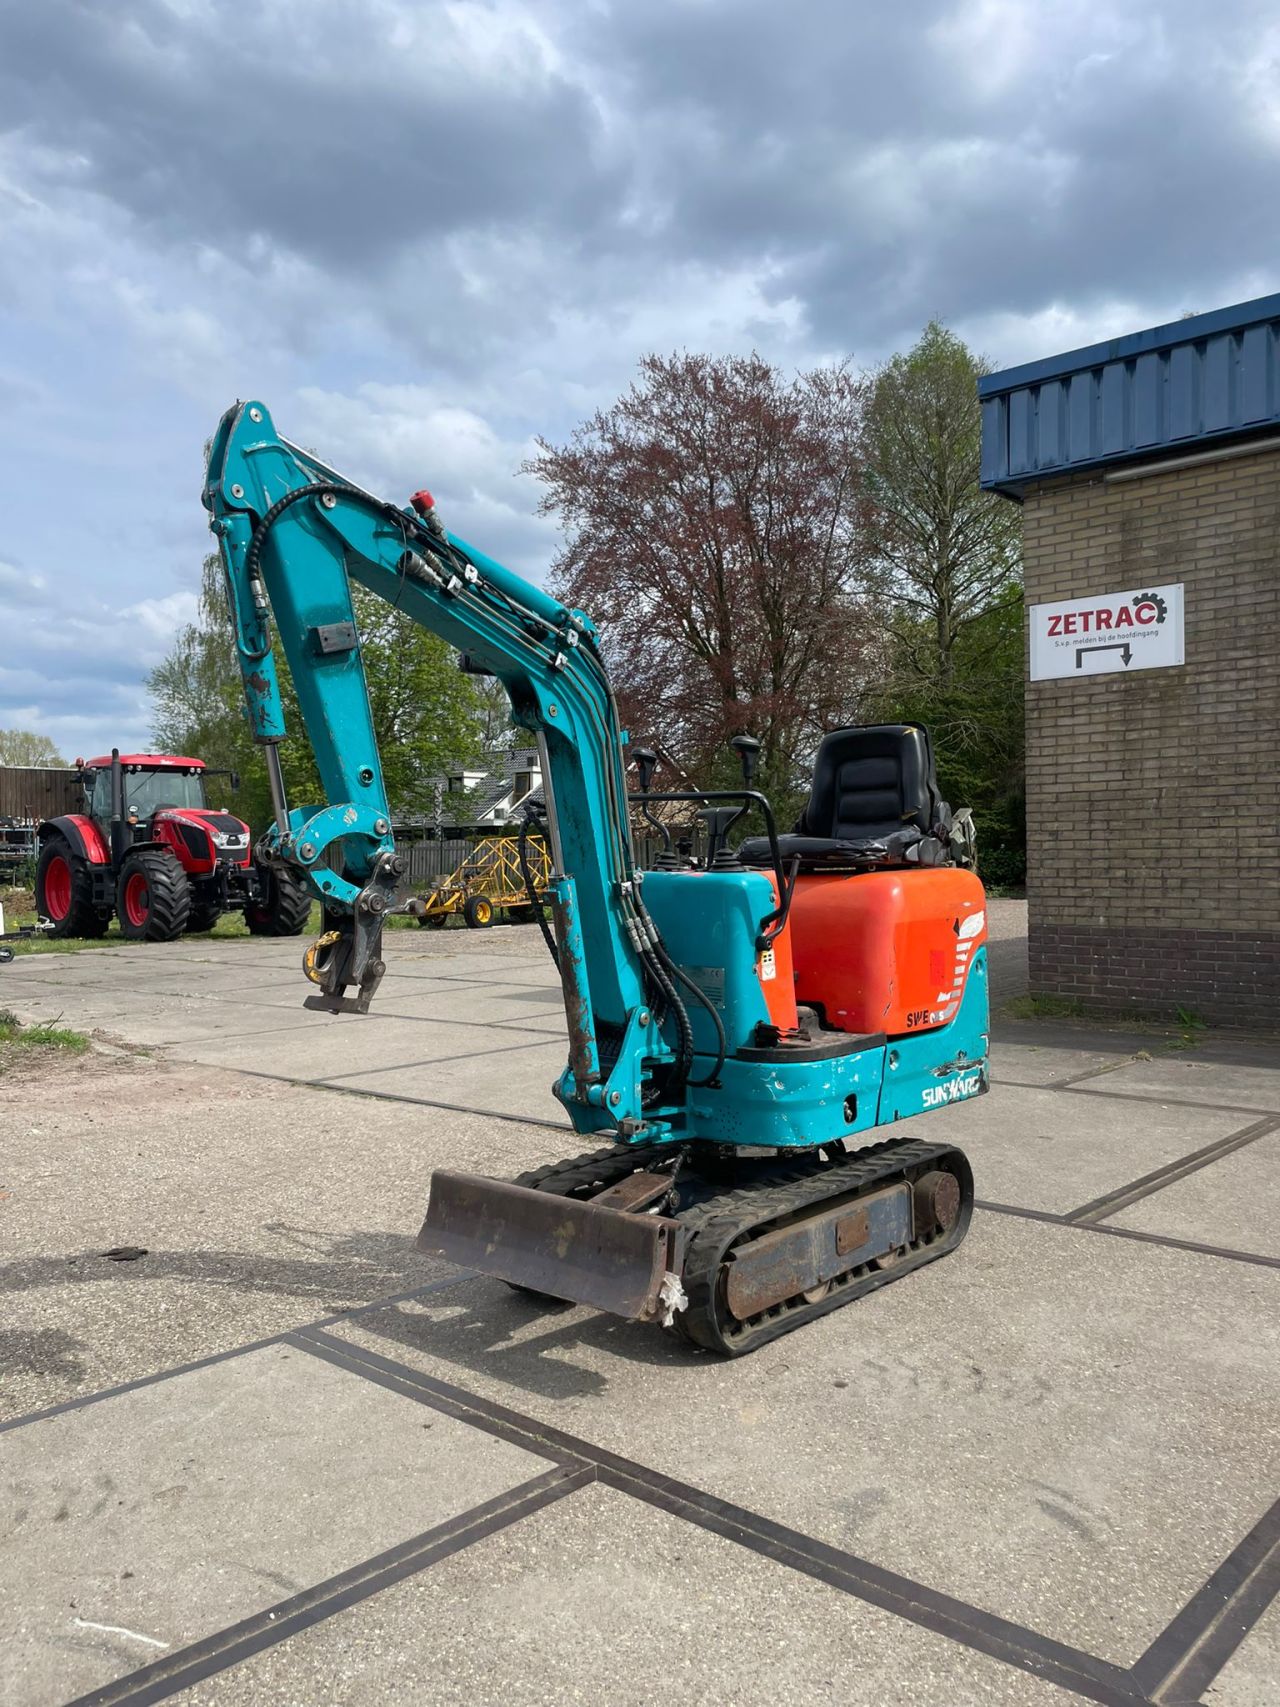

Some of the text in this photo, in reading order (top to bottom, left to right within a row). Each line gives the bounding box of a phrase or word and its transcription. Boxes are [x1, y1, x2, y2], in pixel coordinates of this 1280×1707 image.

[1047, 603, 1156, 636] ZETRAC
[1073, 636, 1097, 645] melden
[1098, 635, 1106, 643] bij
[1117, 630, 1159, 640] hoofdingang
